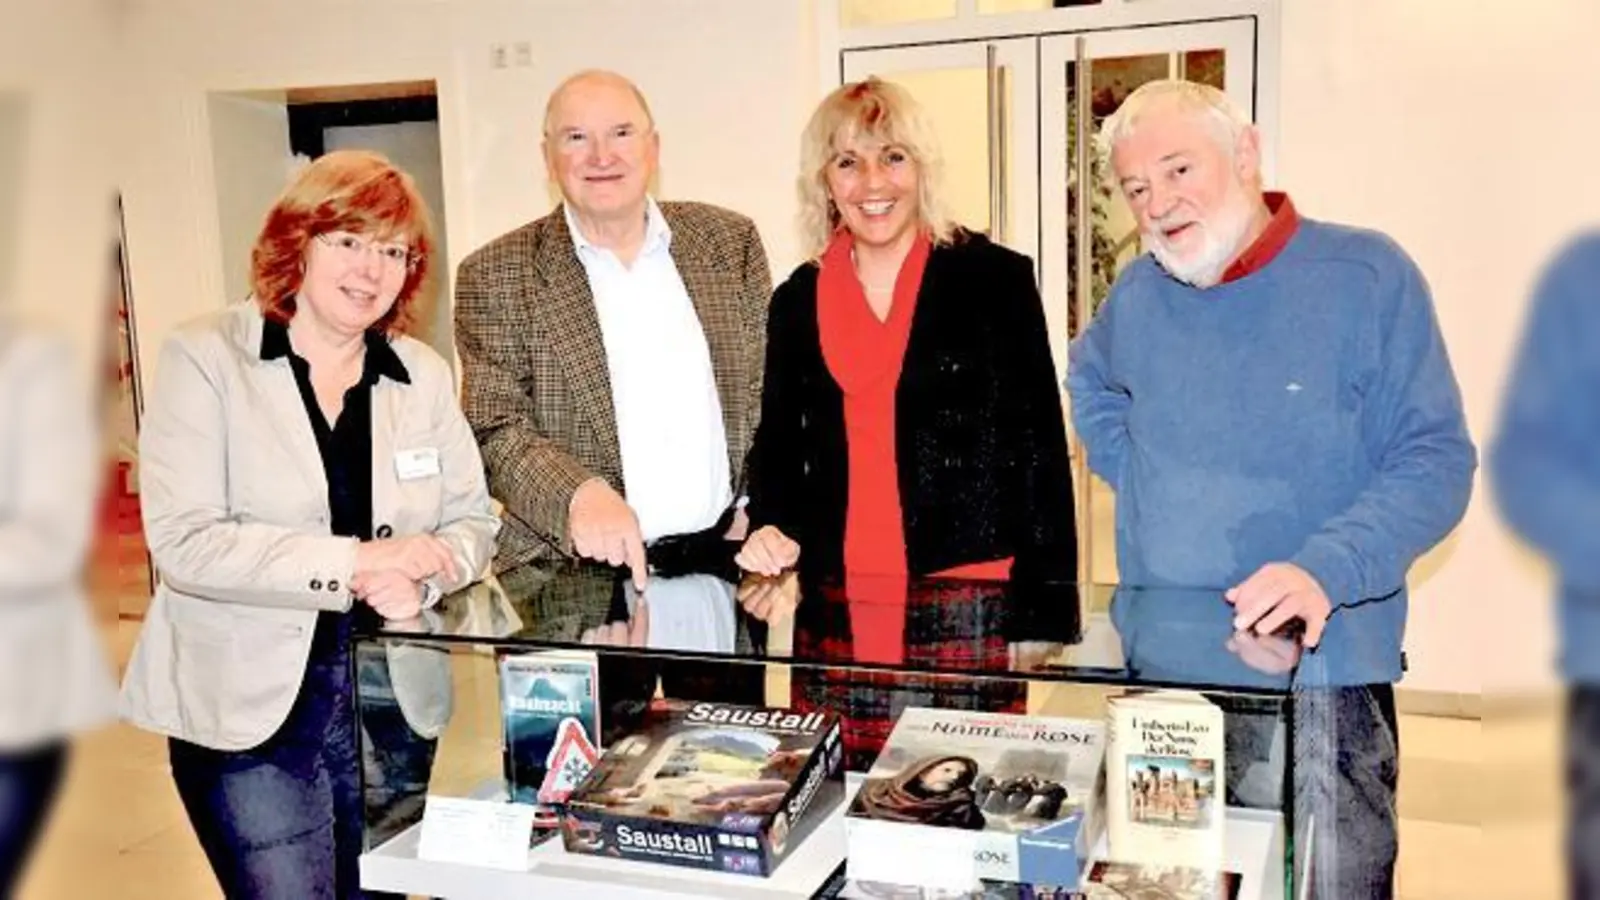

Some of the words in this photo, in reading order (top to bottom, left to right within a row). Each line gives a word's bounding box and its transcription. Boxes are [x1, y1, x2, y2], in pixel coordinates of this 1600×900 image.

[688, 702, 825, 731] Saustall
[932, 721, 1003, 738] NAME
[1033, 730, 1097, 746] ROSE
[616, 824, 714, 855] Saustall
